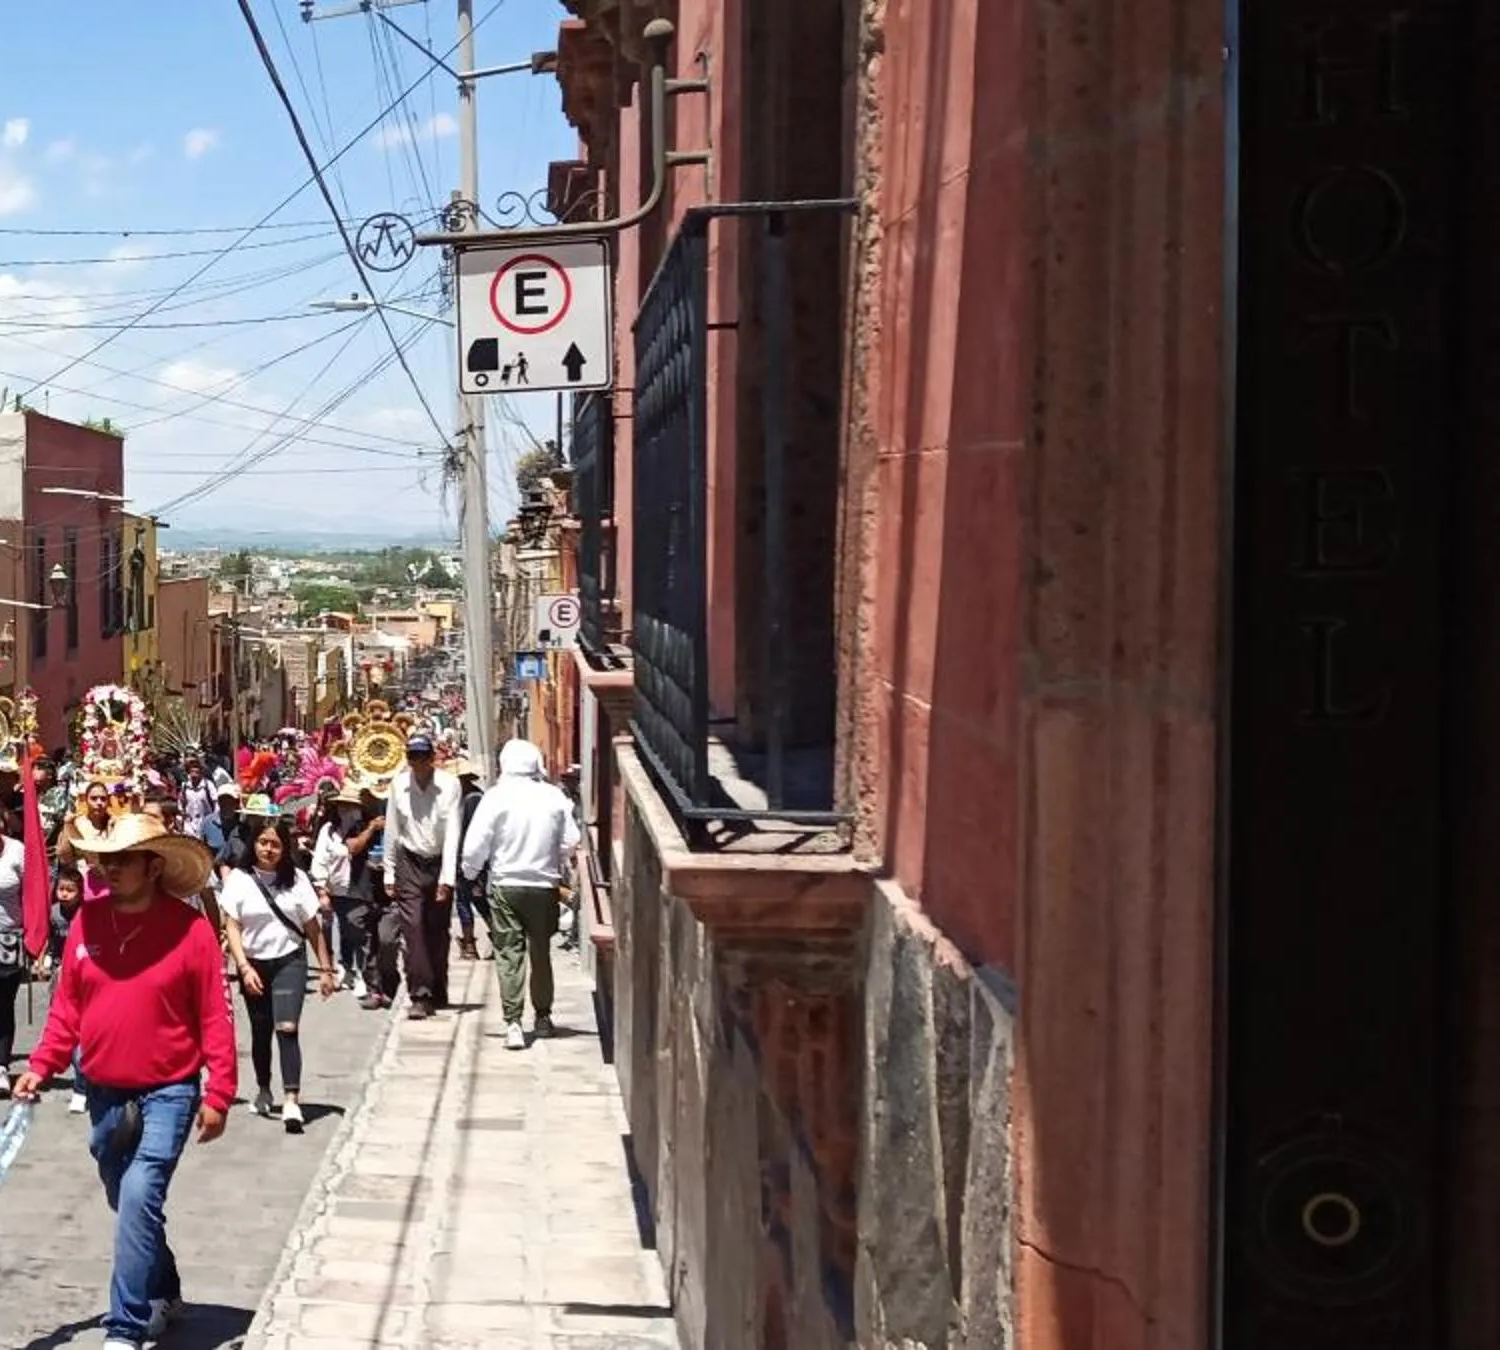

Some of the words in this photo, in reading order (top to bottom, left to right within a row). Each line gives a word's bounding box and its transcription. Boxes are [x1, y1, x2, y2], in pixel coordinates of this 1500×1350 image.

[515, 271, 548, 315] E
[1284, 10, 1411, 727] HOTEL
[557, 604, 571, 621] E
